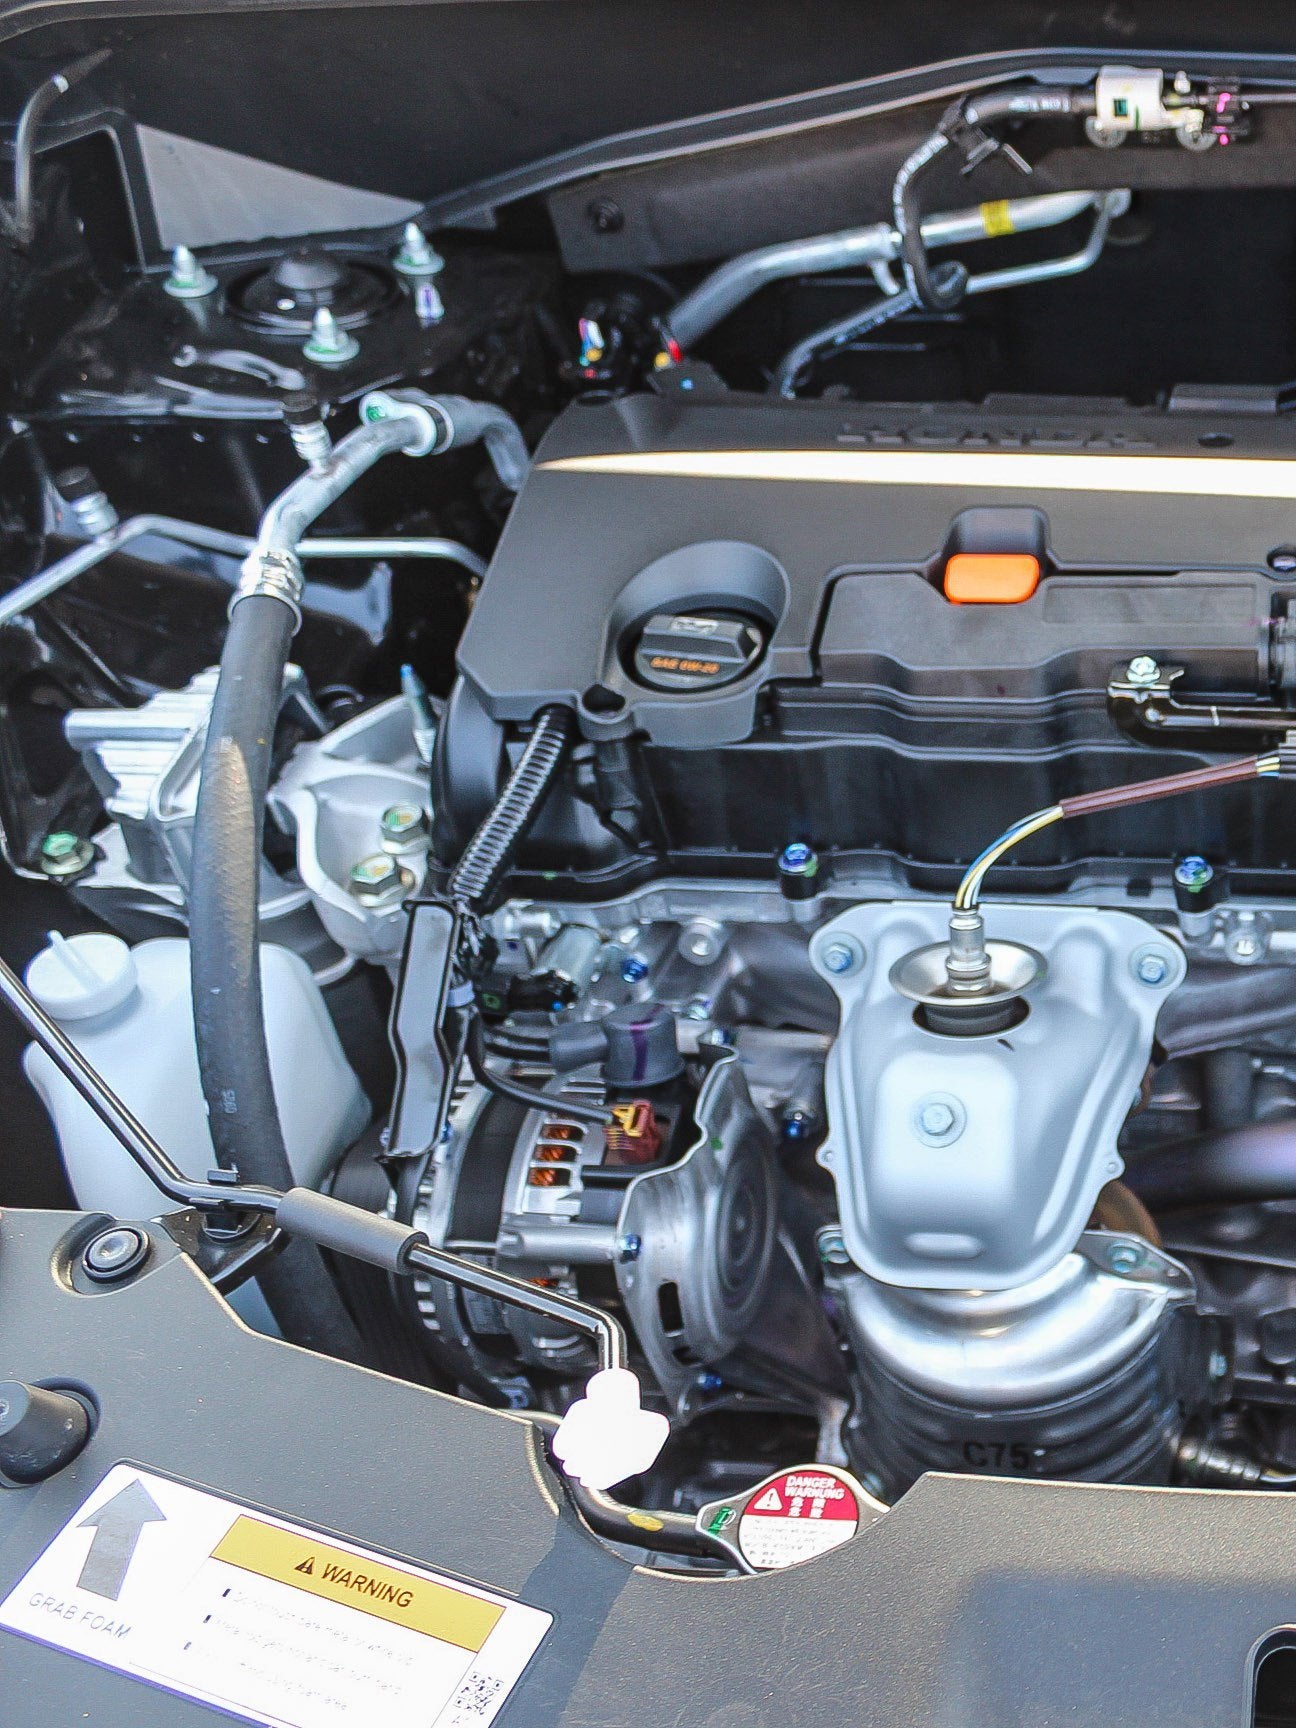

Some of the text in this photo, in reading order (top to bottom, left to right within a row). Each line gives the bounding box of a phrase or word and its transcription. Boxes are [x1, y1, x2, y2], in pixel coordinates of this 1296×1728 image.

[784, 1486, 845, 1500] WARNUNG
[786, 1475, 837, 1489] DANGER
[321, 1563, 414, 1608] WARNING
[29, 1592, 132, 1638] GRAB FOAM
